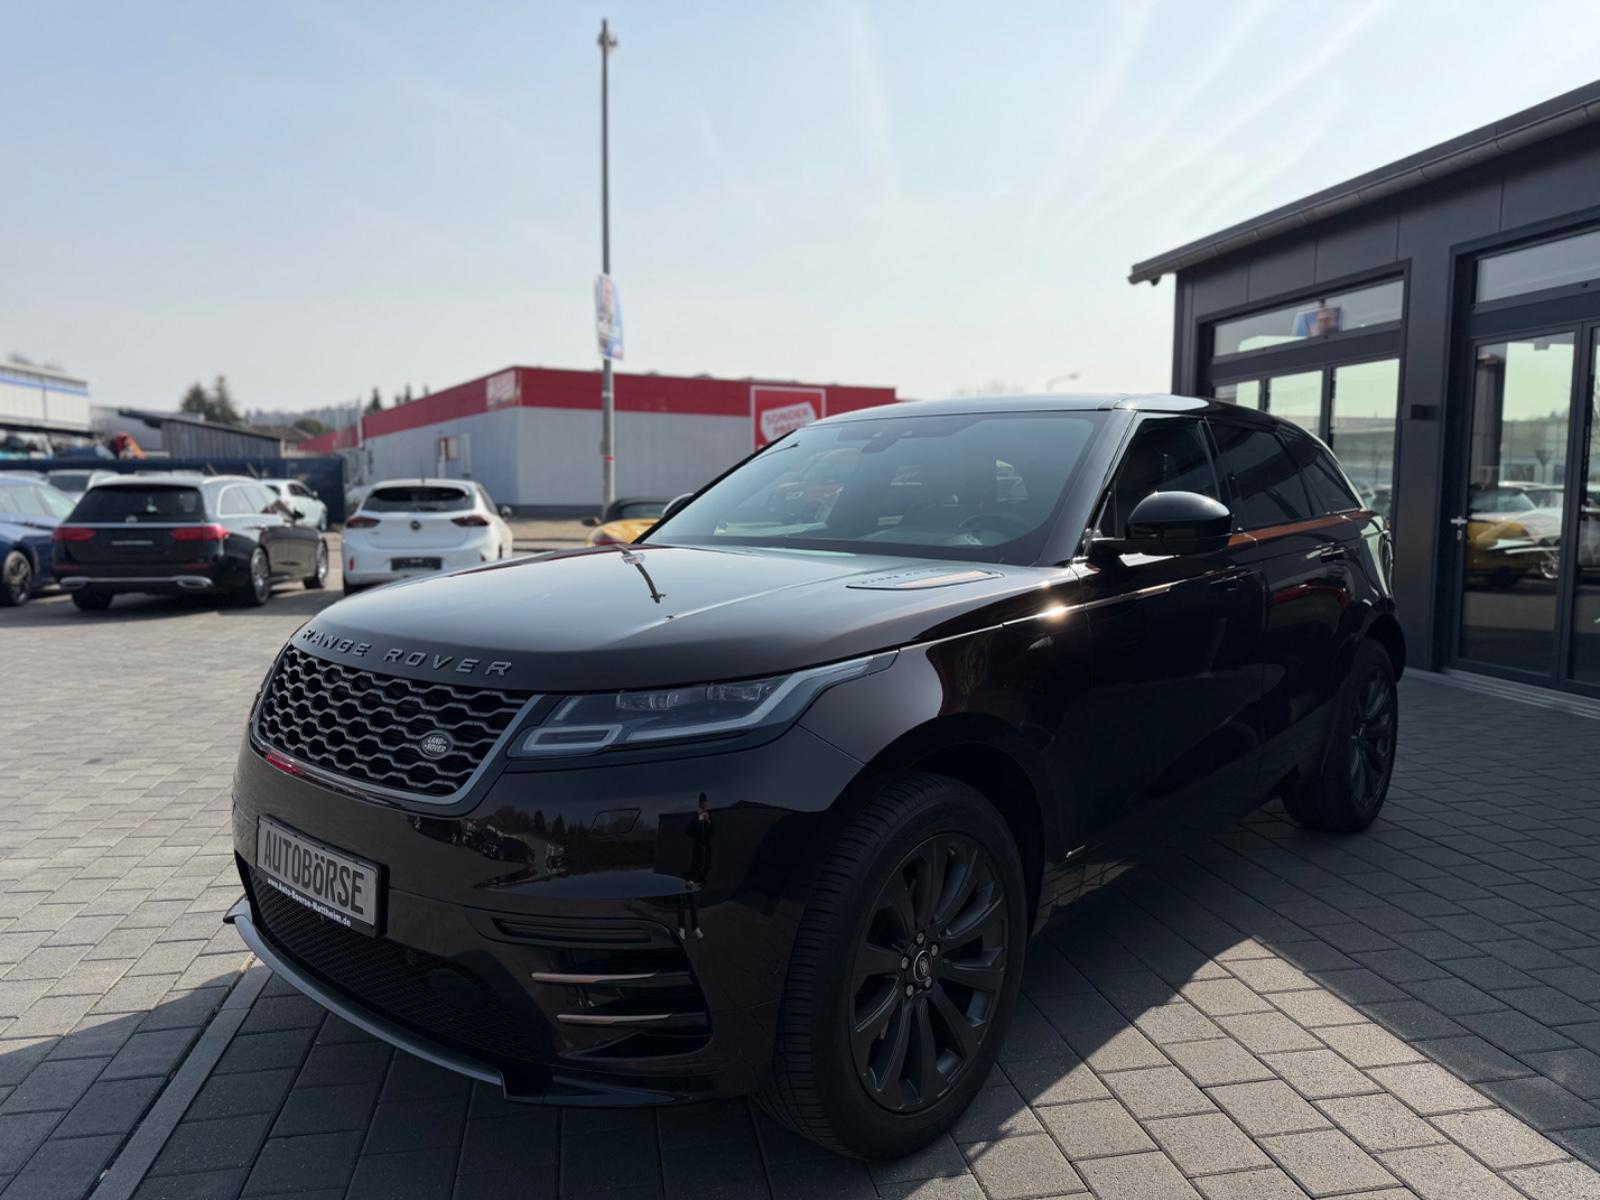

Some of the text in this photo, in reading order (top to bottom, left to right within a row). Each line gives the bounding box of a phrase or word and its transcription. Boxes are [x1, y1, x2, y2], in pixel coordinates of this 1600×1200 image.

[302, 628, 512, 677] RANGE ROVER
[263, 829, 365, 915] AUTOBÖRSE
